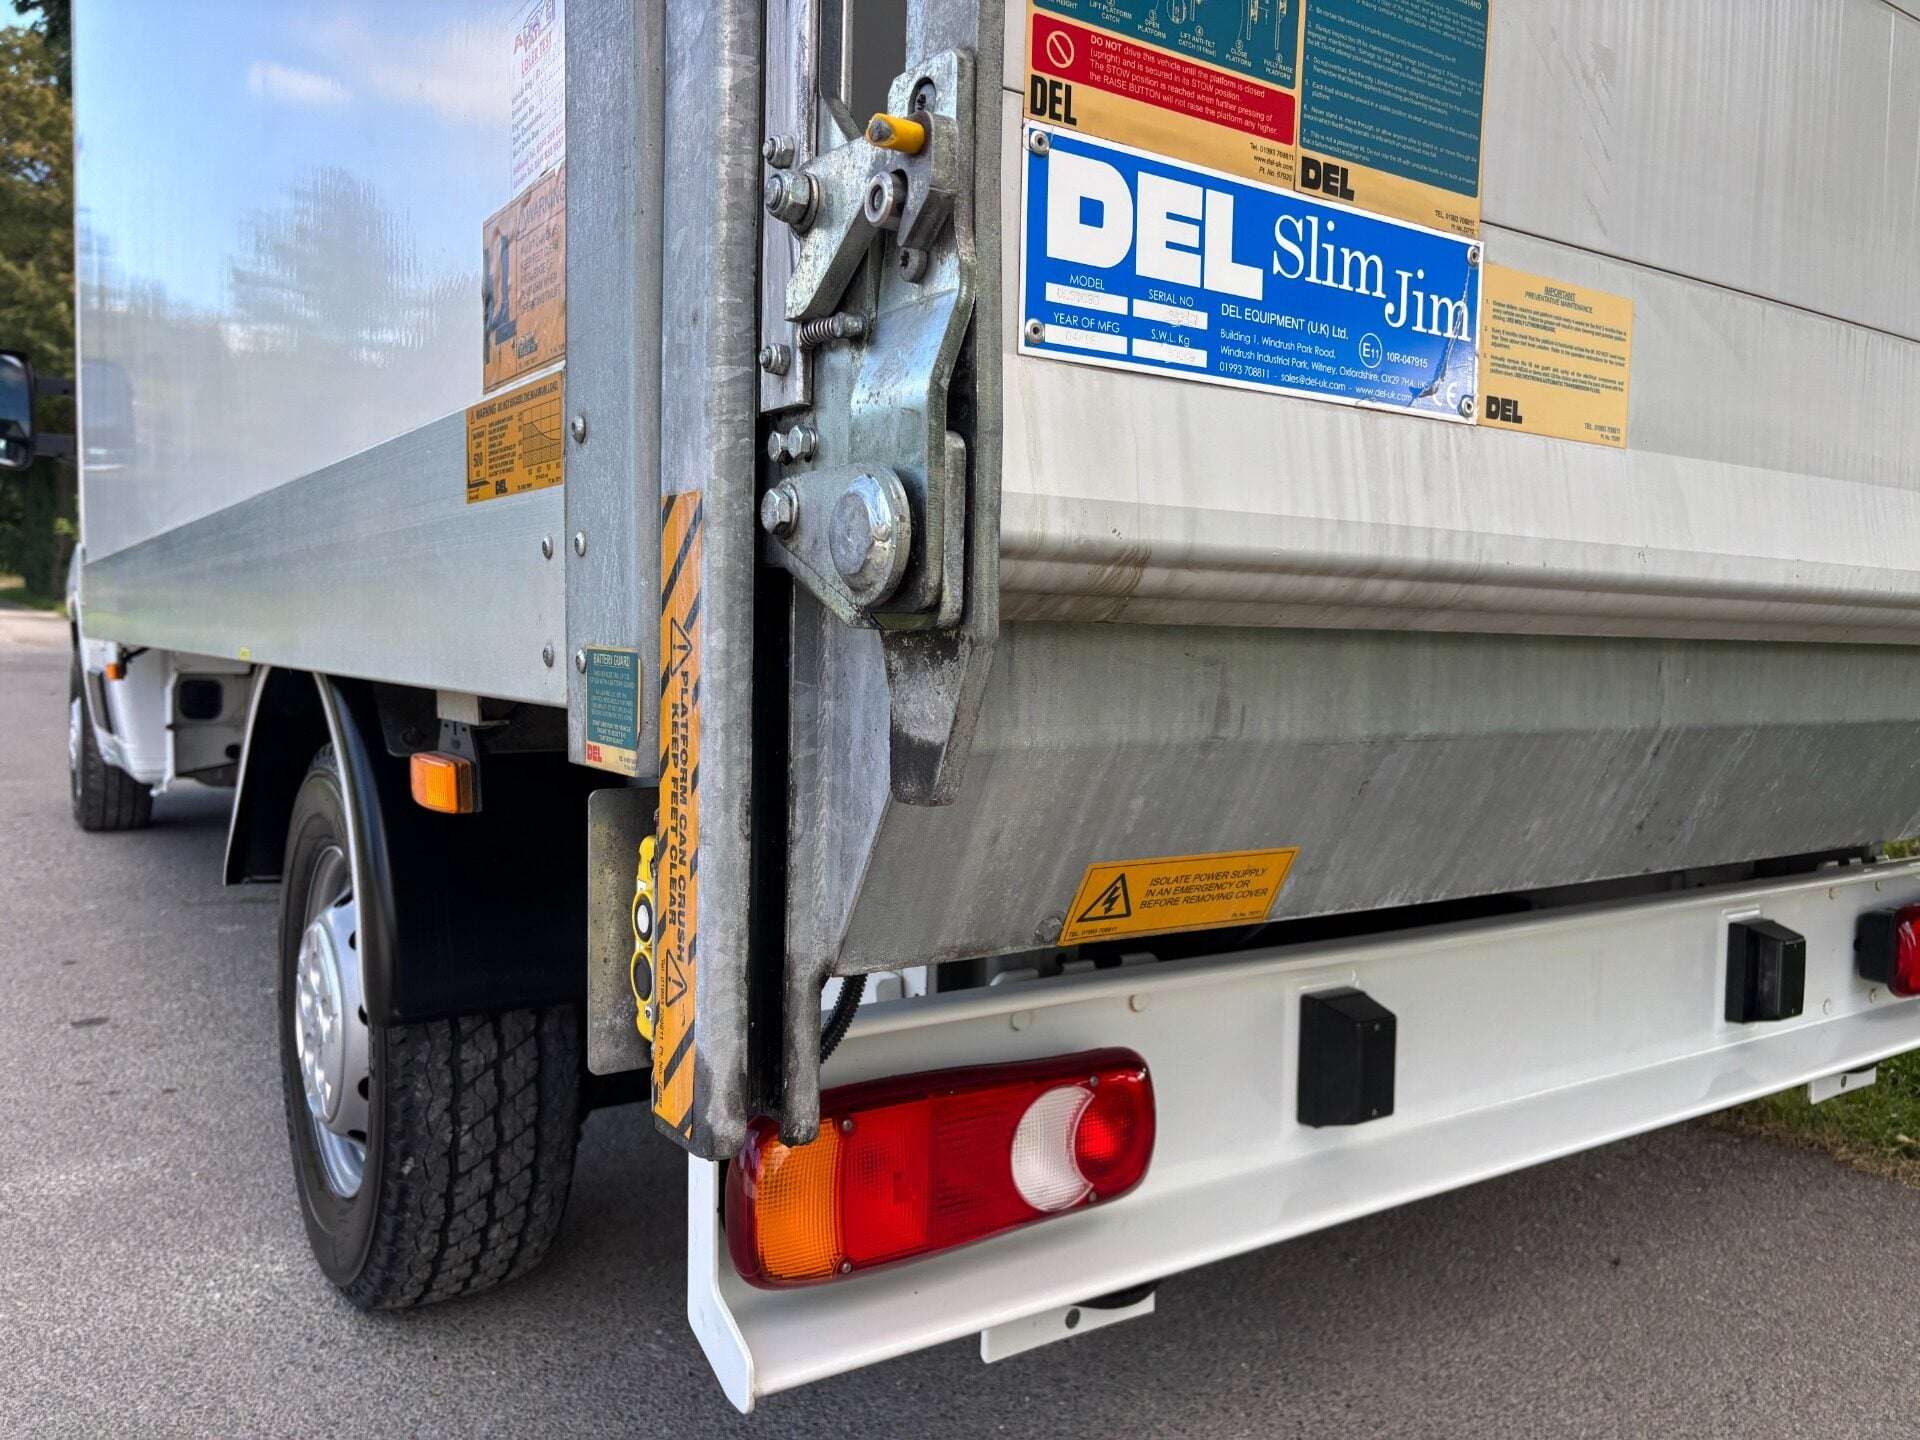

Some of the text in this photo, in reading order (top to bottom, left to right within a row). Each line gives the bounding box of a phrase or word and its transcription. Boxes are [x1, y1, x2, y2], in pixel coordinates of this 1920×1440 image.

[1101, 12, 1120, 24] CATCH
[1138, 24, 1166, 39] PLATFORM
[1180, 31, 1191, 40] LIFT
[1178, 38, 1196, 50] CATCH
[1090, 35, 1264, 98] DO NOT drive this vehicle until the platform is closed
[1090, 48, 1120, 64] (upright)
[1123, 58, 1136, 69] and
[1137, 62, 1143, 71] is
[1145, 66, 1172, 80] secured
[1174, 74, 1180, 83] in
[1182, 77, 1190, 85] its
[1192, 79, 1213, 93] STOW
[1225, 54, 1252, 67] PLATFORM
[1030, 74, 1077, 126] DEL
[1090, 59, 1272, 122] The STOW position is reached when further pressing of
[1090, 72, 1101, 81] the
[1103, 75, 1127, 90] RAISE
[1129, 82, 1160, 99] BUTTON
[1162, 95, 1174, 103] will
[1175, 98, 1186, 108] not
[1187, 101, 1204, 112] raise
[1205, 106, 1216, 116] the
[1217, 110, 1242, 125] platform
[1244, 119, 1256, 130] any
[1301, 156, 1354, 201] DEL
[1046, 148, 1264, 300] DEL
[1272, 213, 1387, 300] Slim
[1384, 268, 1472, 343] Jim
[1070, 274, 1105, 290] MODEL
[1149, 288, 1194, 307] SERIAL NO
[1544, 286, 1576, 300] IMPORTANT
[1054, 312, 1120, 334] YEAR OF MFG
[1221, 303, 1349, 340] DEL EQUIPMENT (U.K) Ltd.
[1152, 329, 1190, 348] S.W.L. Kg
[1220, 329, 1250, 344] Building
[1262, 336, 1295, 351] Windrush
[1297, 343, 1312, 354] Park
[1220, 345, 1255, 360] Windrush
[1257, 352, 1290, 366] Industrial
[1387, 352, 1428, 368] 10R-047915
[1220, 361, 1242, 375] 01993
[1244, 366, 1270, 379] 708811
[1280, 372, 1346, 390] sales@del-uk.com
[1356, 386, 1413, 401] www.del-uk.com
[1486, 395, 1523, 424] DEL
[593, 653, 630, 667] BATTERY GUARD
[587, 743, 603, 764] DEL
[668, 704, 680, 925] KEEP FEET CLEAR
[676, 670, 690, 964] PLATFORM CAN CRUSH
[1150, 867, 1268, 886] ISOLATE POWER SUPPLY
[1139, 887, 1269, 910] BEFORE REMOVING COVER
[1145, 880, 1251, 897] IN AN EMERGENCY OR
